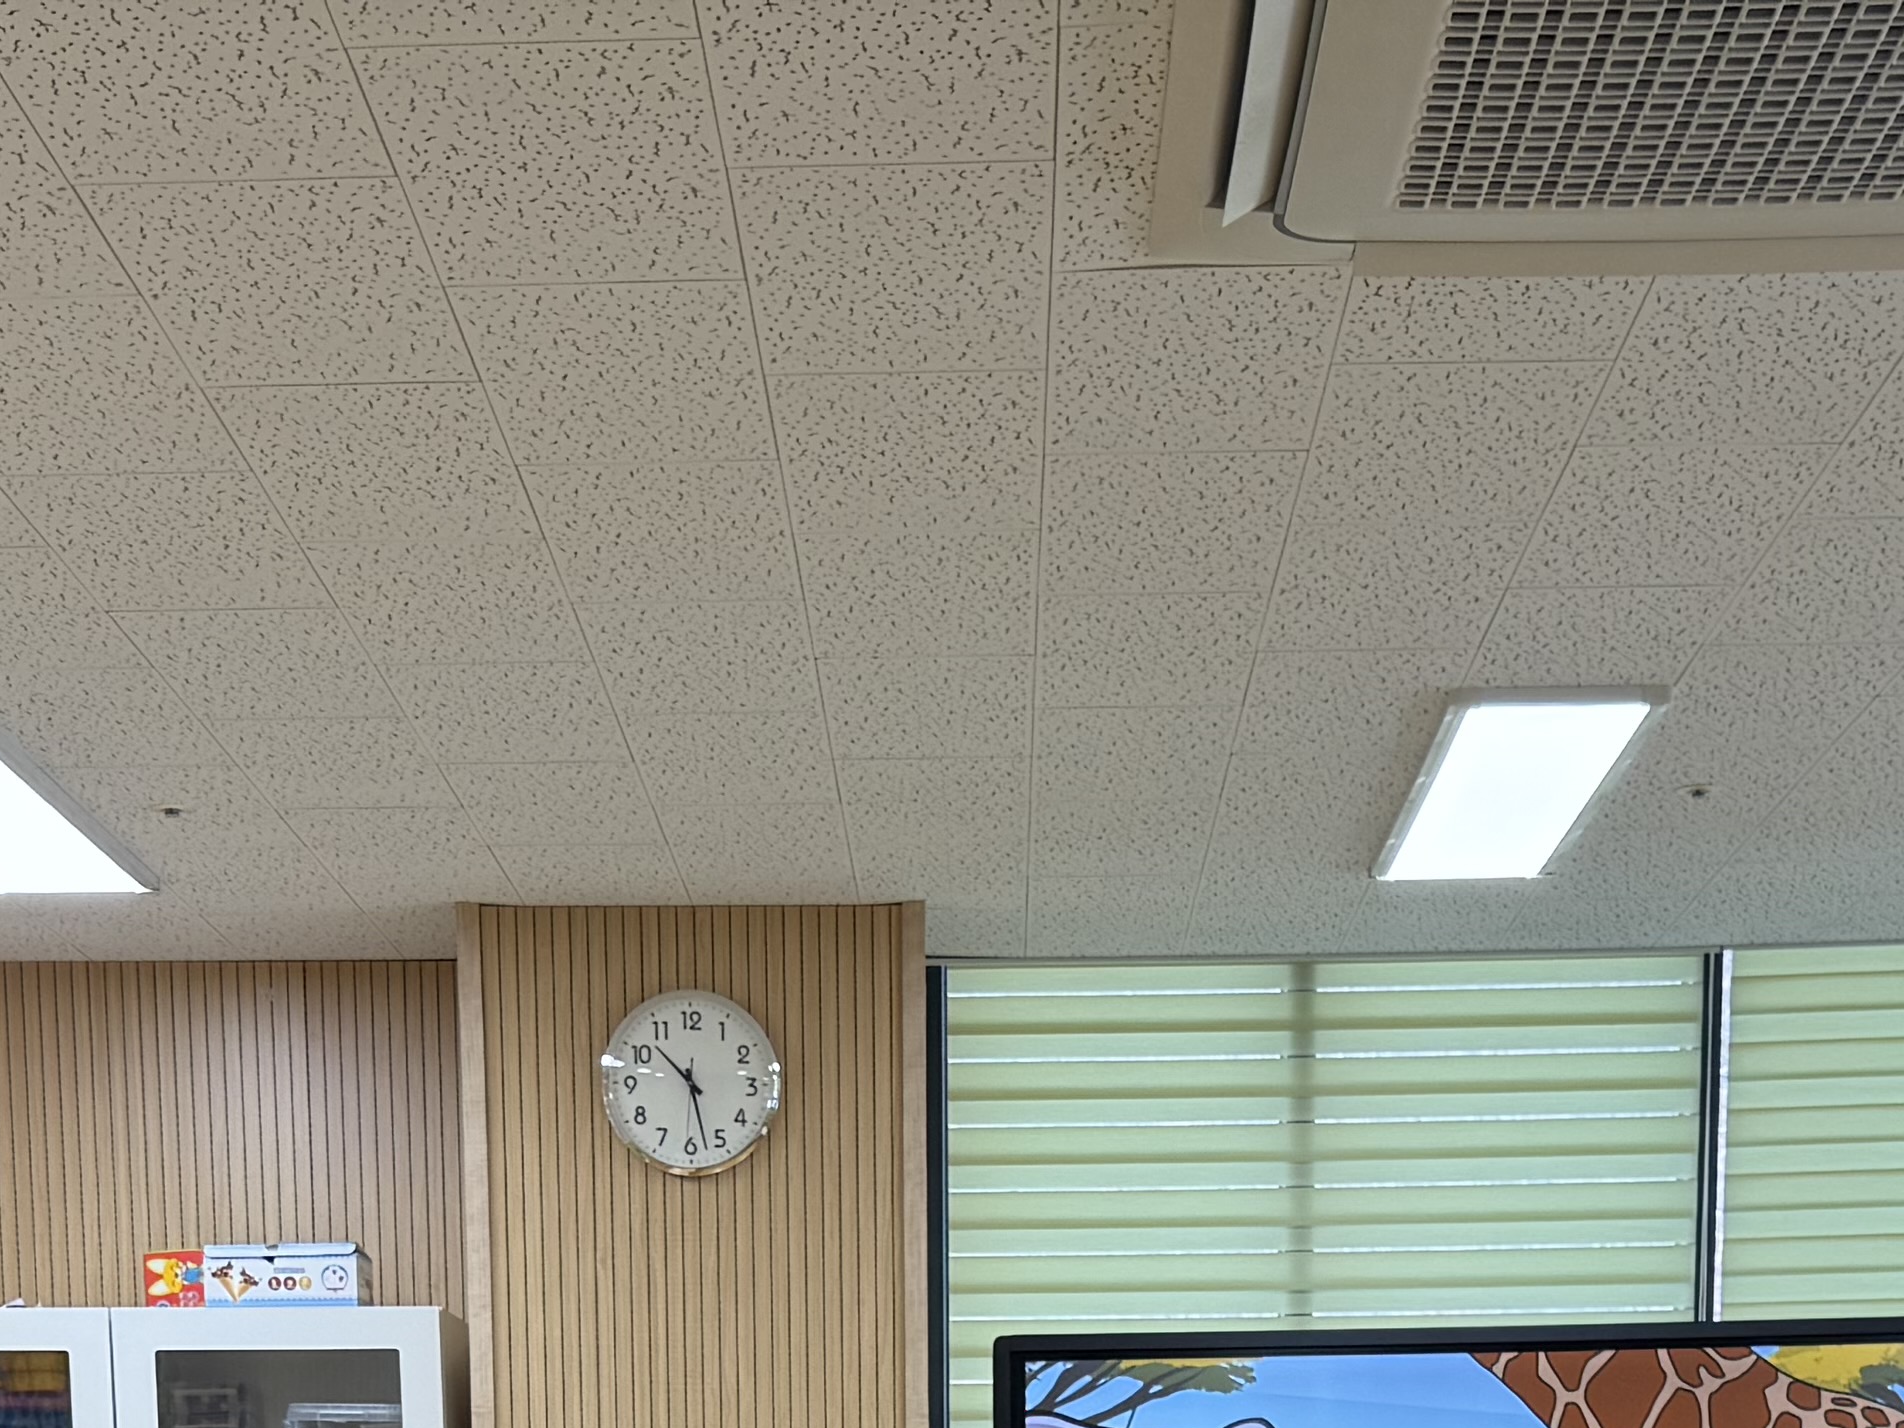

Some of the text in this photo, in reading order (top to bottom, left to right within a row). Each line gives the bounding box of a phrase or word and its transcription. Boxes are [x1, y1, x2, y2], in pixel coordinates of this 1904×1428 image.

[680, 1010, 702, 1031] 12
[653, 1021, 669, 1040] 11
[719, 1022, 725, 1040] 1
[632, 1045, 651, 1064] 10
[738, 1045, 750, 1064] 2
[624, 1075, 637, 1094] 9
[745, 1077, 758, 1096] 3
[634, 1106, 646, 1124] 8
[734, 1108, 747, 1126] 4
[656, 1128, 668, 1146] 7
[684, 1137, 697, 1155] 6
[714, 1129, 726, 1148] 5
